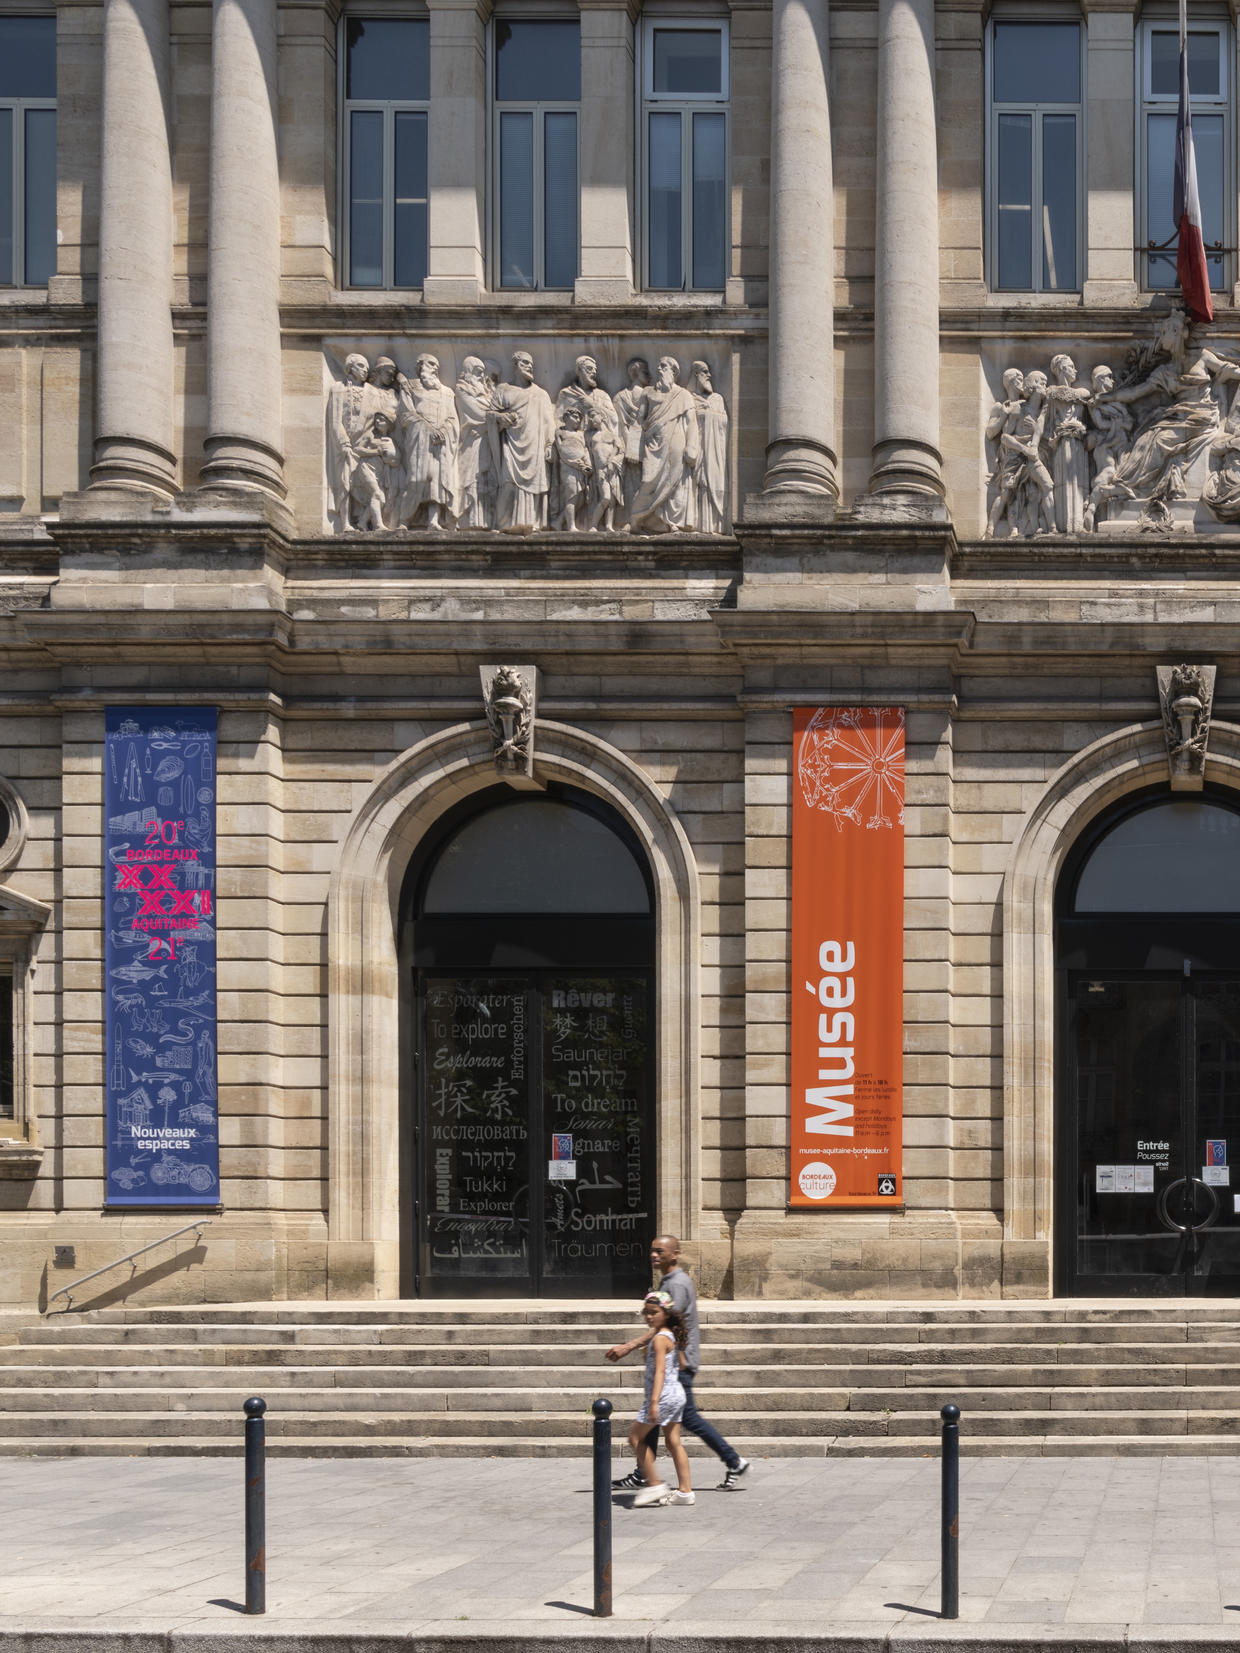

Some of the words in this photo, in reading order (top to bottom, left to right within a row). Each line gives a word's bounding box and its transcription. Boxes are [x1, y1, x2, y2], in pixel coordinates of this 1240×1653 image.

[127, 849, 199, 861] BORDEAUX
[115, 864, 178, 889] XX
[131, 918, 201, 931] AQUITAINE
[551, 989, 616, 1008] Rêver
[432, 1019, 447, 1039] To
[451, 1018, 507, 1045] explore
[552, 1012, 609, 1043] 梦想
[511, 996, 524, 1080] Erforschen
[805, 940, 856, 1137] Musée
[433, 1047, 505, 1072] Esplorare
[551, 1045, 633, 1065] Saunejar
[432, 1076, 519, 1120] 探索
[551, 1093, 576, 1113] To
[581, 1093, 638, 1113] dream
[131, 1126, 196, 1138] Nouveaux
[432, 1125, 528, 1143] исследовать
[137, 1139, 191, 1152] espaces
[574, 1138, 621, 1156] gnare
[799, 1147, 889, 1156] musee-aquitaine-bordeaux.fr
[1137, 1140, 1170, 1150] Entrée
[627, 1116, 641, 1207] Мечтать
[1137, 1152, 1169, 1160] Poussez
[434, 1148, 453, 1213] Explorar
[463, 1176, 507, 1193] Tukki
[799, 1181, 835, 1190] culture
[459, 1198, 516, 1214] Explorer
[571, 1207, 637, 1231] Sonhar
[432, 1237, 527, 1259] استكشاف
[552, 1239, 643, 1257] Träumen
